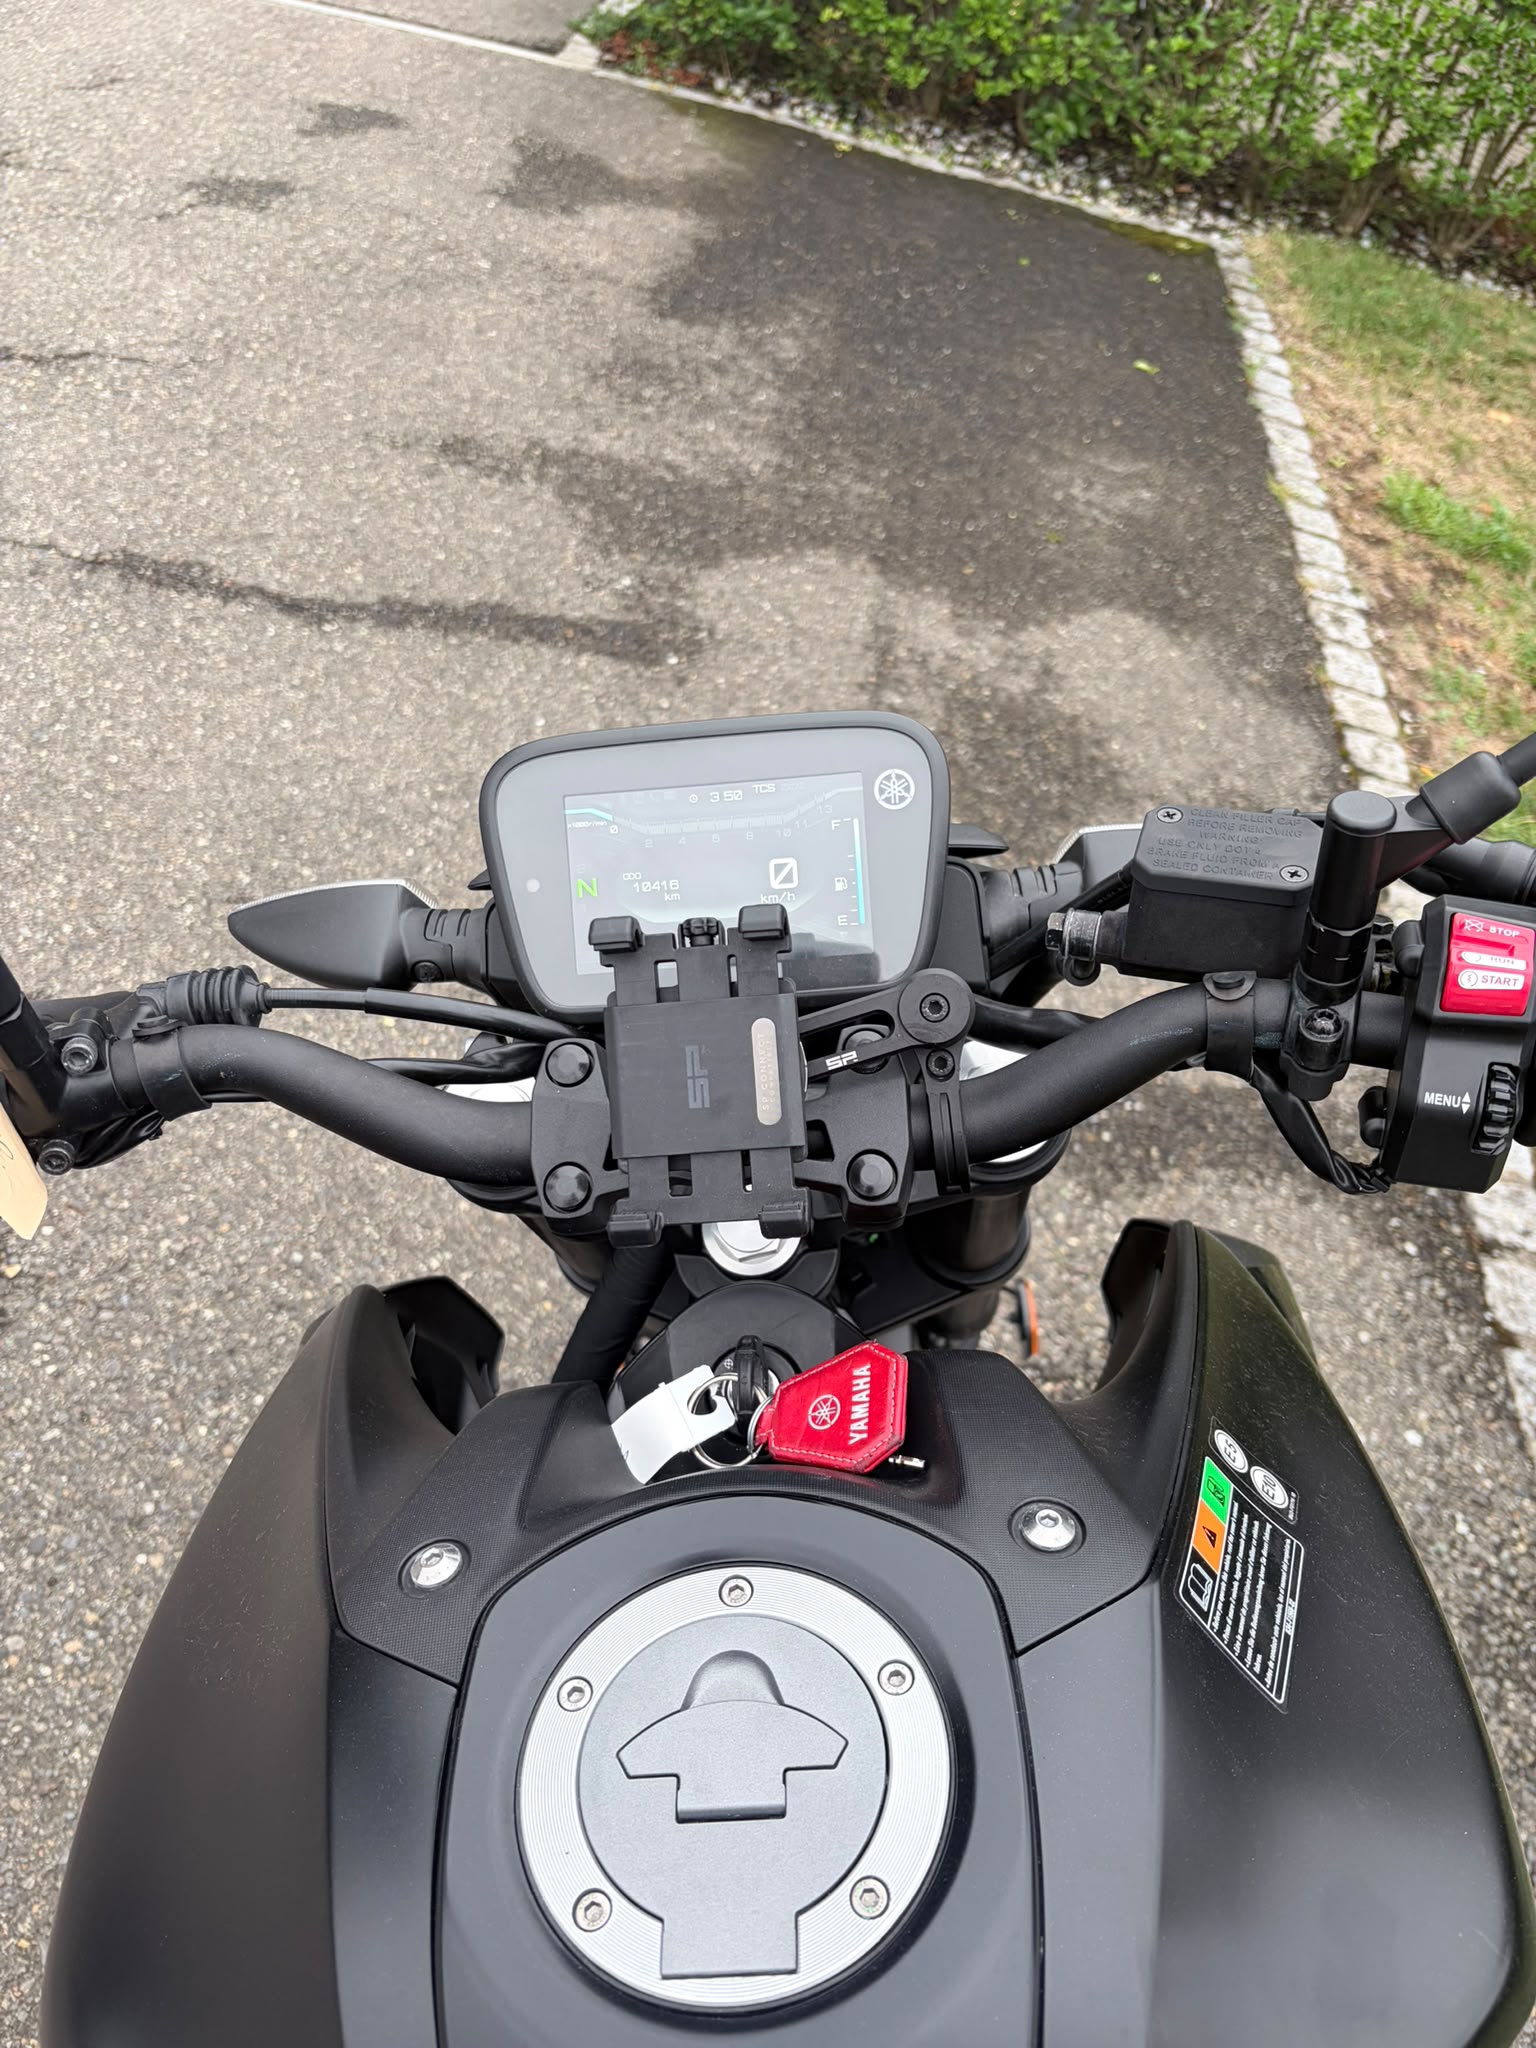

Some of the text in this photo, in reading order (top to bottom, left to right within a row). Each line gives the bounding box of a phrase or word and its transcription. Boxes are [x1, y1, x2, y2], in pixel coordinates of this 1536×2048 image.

[752, 784, 776, 794] TCS
[831, 820, 841, 830] F
[1232, 813, 1273, 824] FILLER
[1187, 818, 1304, 839] BEFORE REMOVING
[1158, 836, 1183, 848] USE
[1192, 852, 1228, 864] FLUID
[769, 856, 798, 889] 0
[1152, 858, 1273, 880] SEALED CONTAINER
[576, 877, 599, 898] N
[633, 879, 680, 893] 10416
[664, 891, 681, 901] km
[760, 891, 796, 904] km/h
[838, 915, 848, 925] E
[1489, 925, 1521, 938] STOP
[1481, 974, 1520, 987] START
[1424, 1092, 1461, 1108] MENU
[848, 1364, 871, 1445] YAMAHA
[1261, 1474, 1277, 1500] E10
